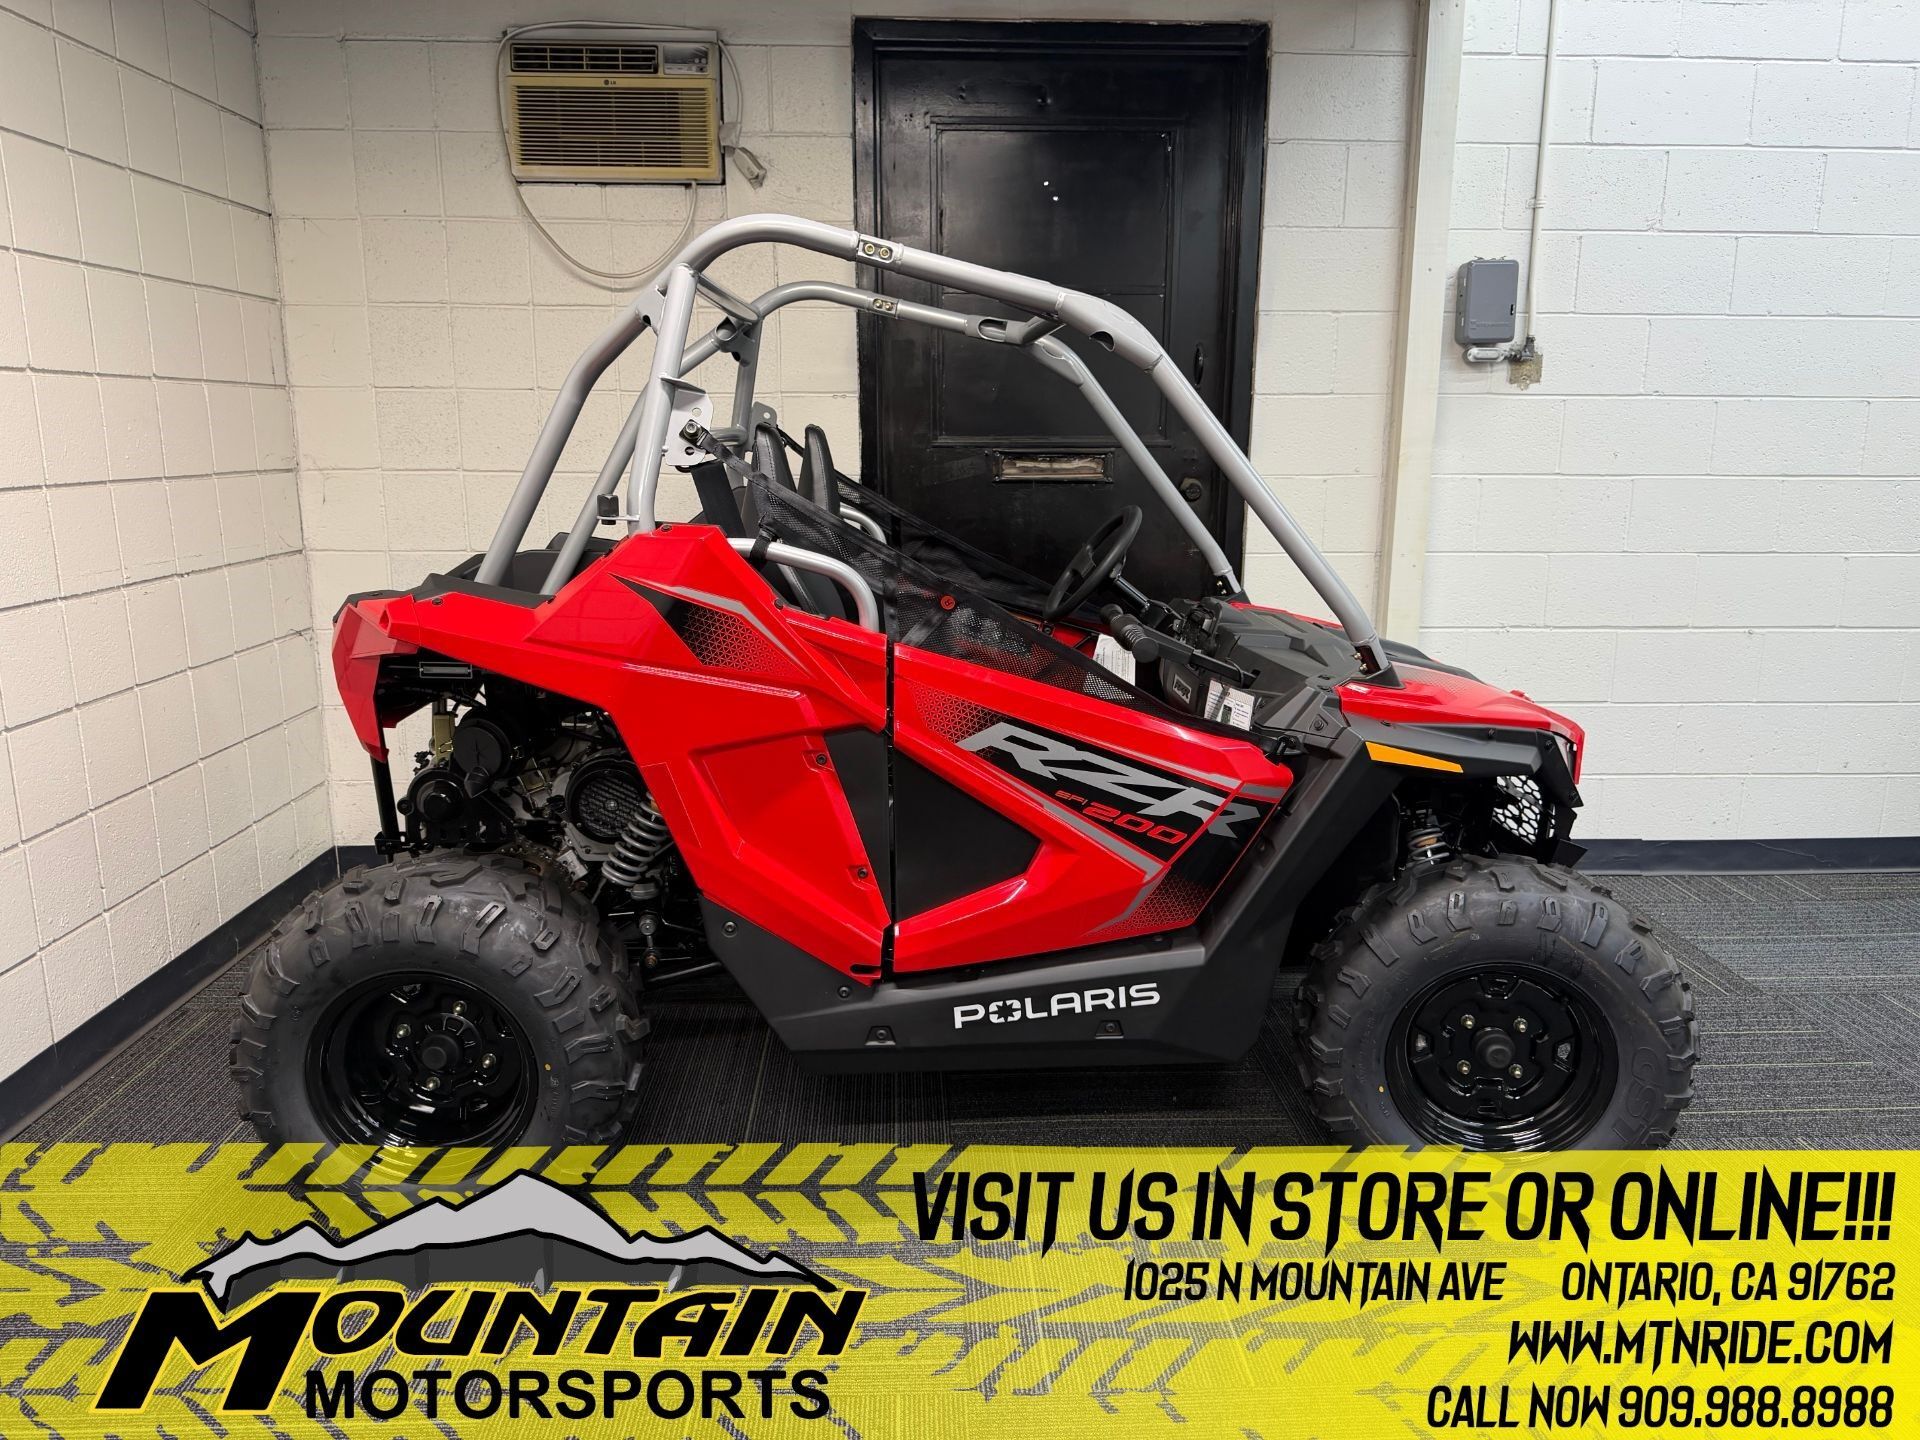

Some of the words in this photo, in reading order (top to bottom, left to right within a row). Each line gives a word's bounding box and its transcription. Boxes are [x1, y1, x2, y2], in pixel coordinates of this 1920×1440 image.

[956, 722, 1260, 838] RZR
[1054, 790, 1088, 806] EFI
[1082, 803, 1187, 844] 200
[953, 983, 1160, 1029] POLARIS
